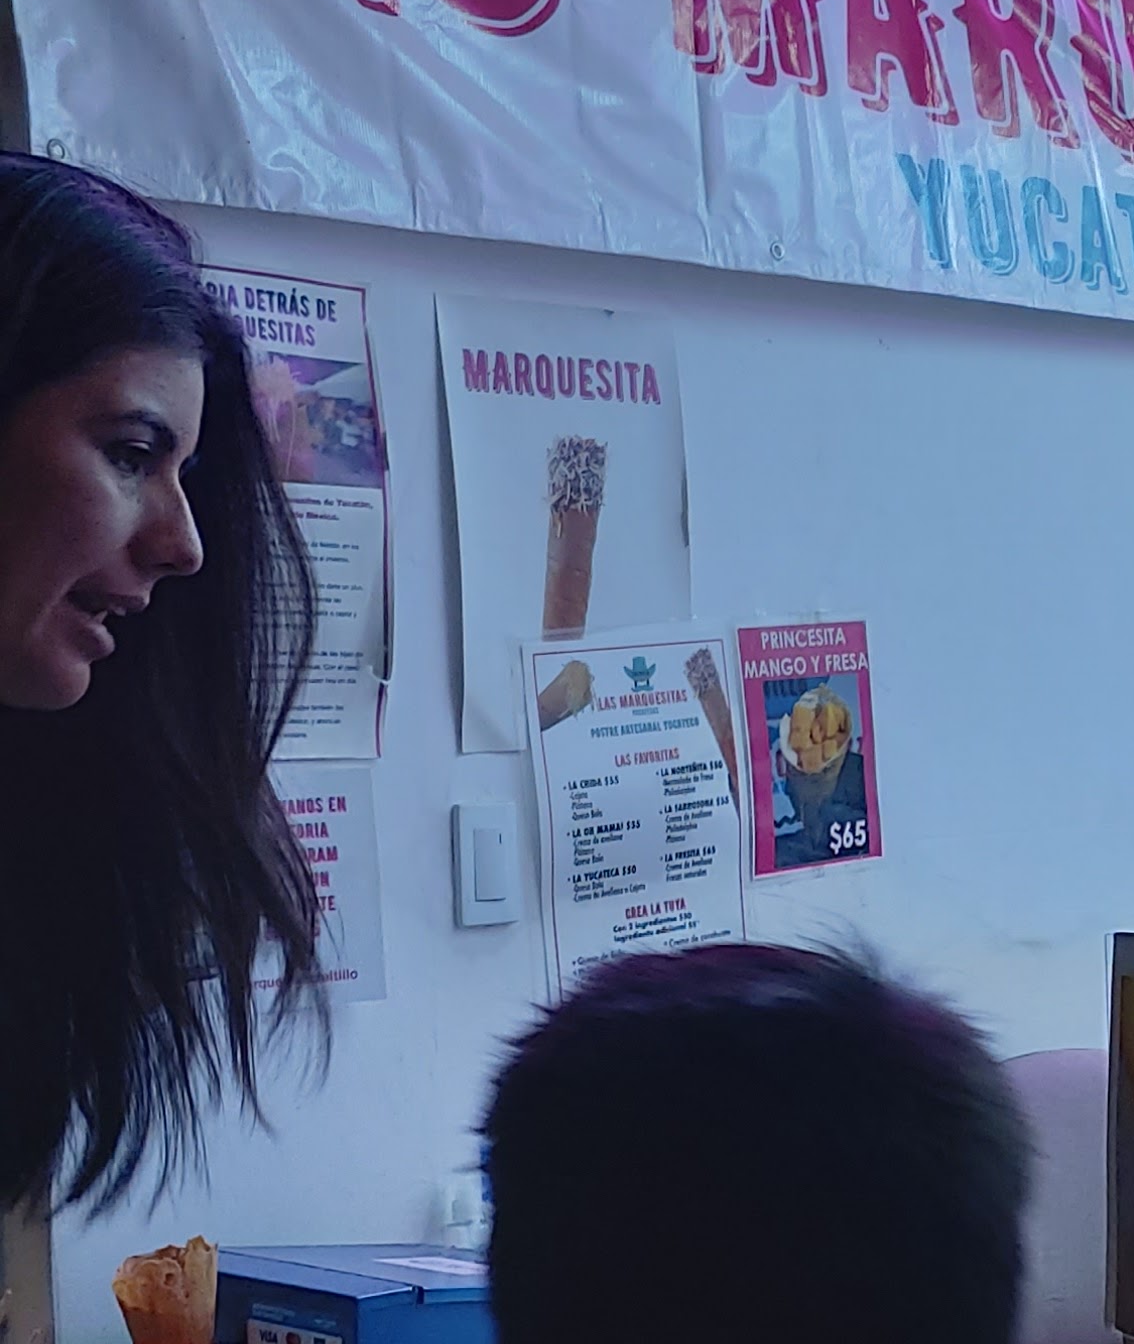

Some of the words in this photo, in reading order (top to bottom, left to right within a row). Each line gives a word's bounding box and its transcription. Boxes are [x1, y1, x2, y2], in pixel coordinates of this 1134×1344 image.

[244, 287, 310, 318] DETRÁS
[316, 298, 338, 323] DE
[462, 348, 661, 405] MARQUESITA
[761, 626, 847, 650] PRINCESITA
[744, 656, 807, 679] MANGO
[811, 655, 820, 674] Y
[825, 652, 869, 674] FRESA
[598, 696, 617, 711] LAS
[619, 690, 688, 709] MARQUESITAS
[614, 753, 631, 767] LAS
[329, 796, 347, 812] EN
[829, 819, 867, 855] $65
